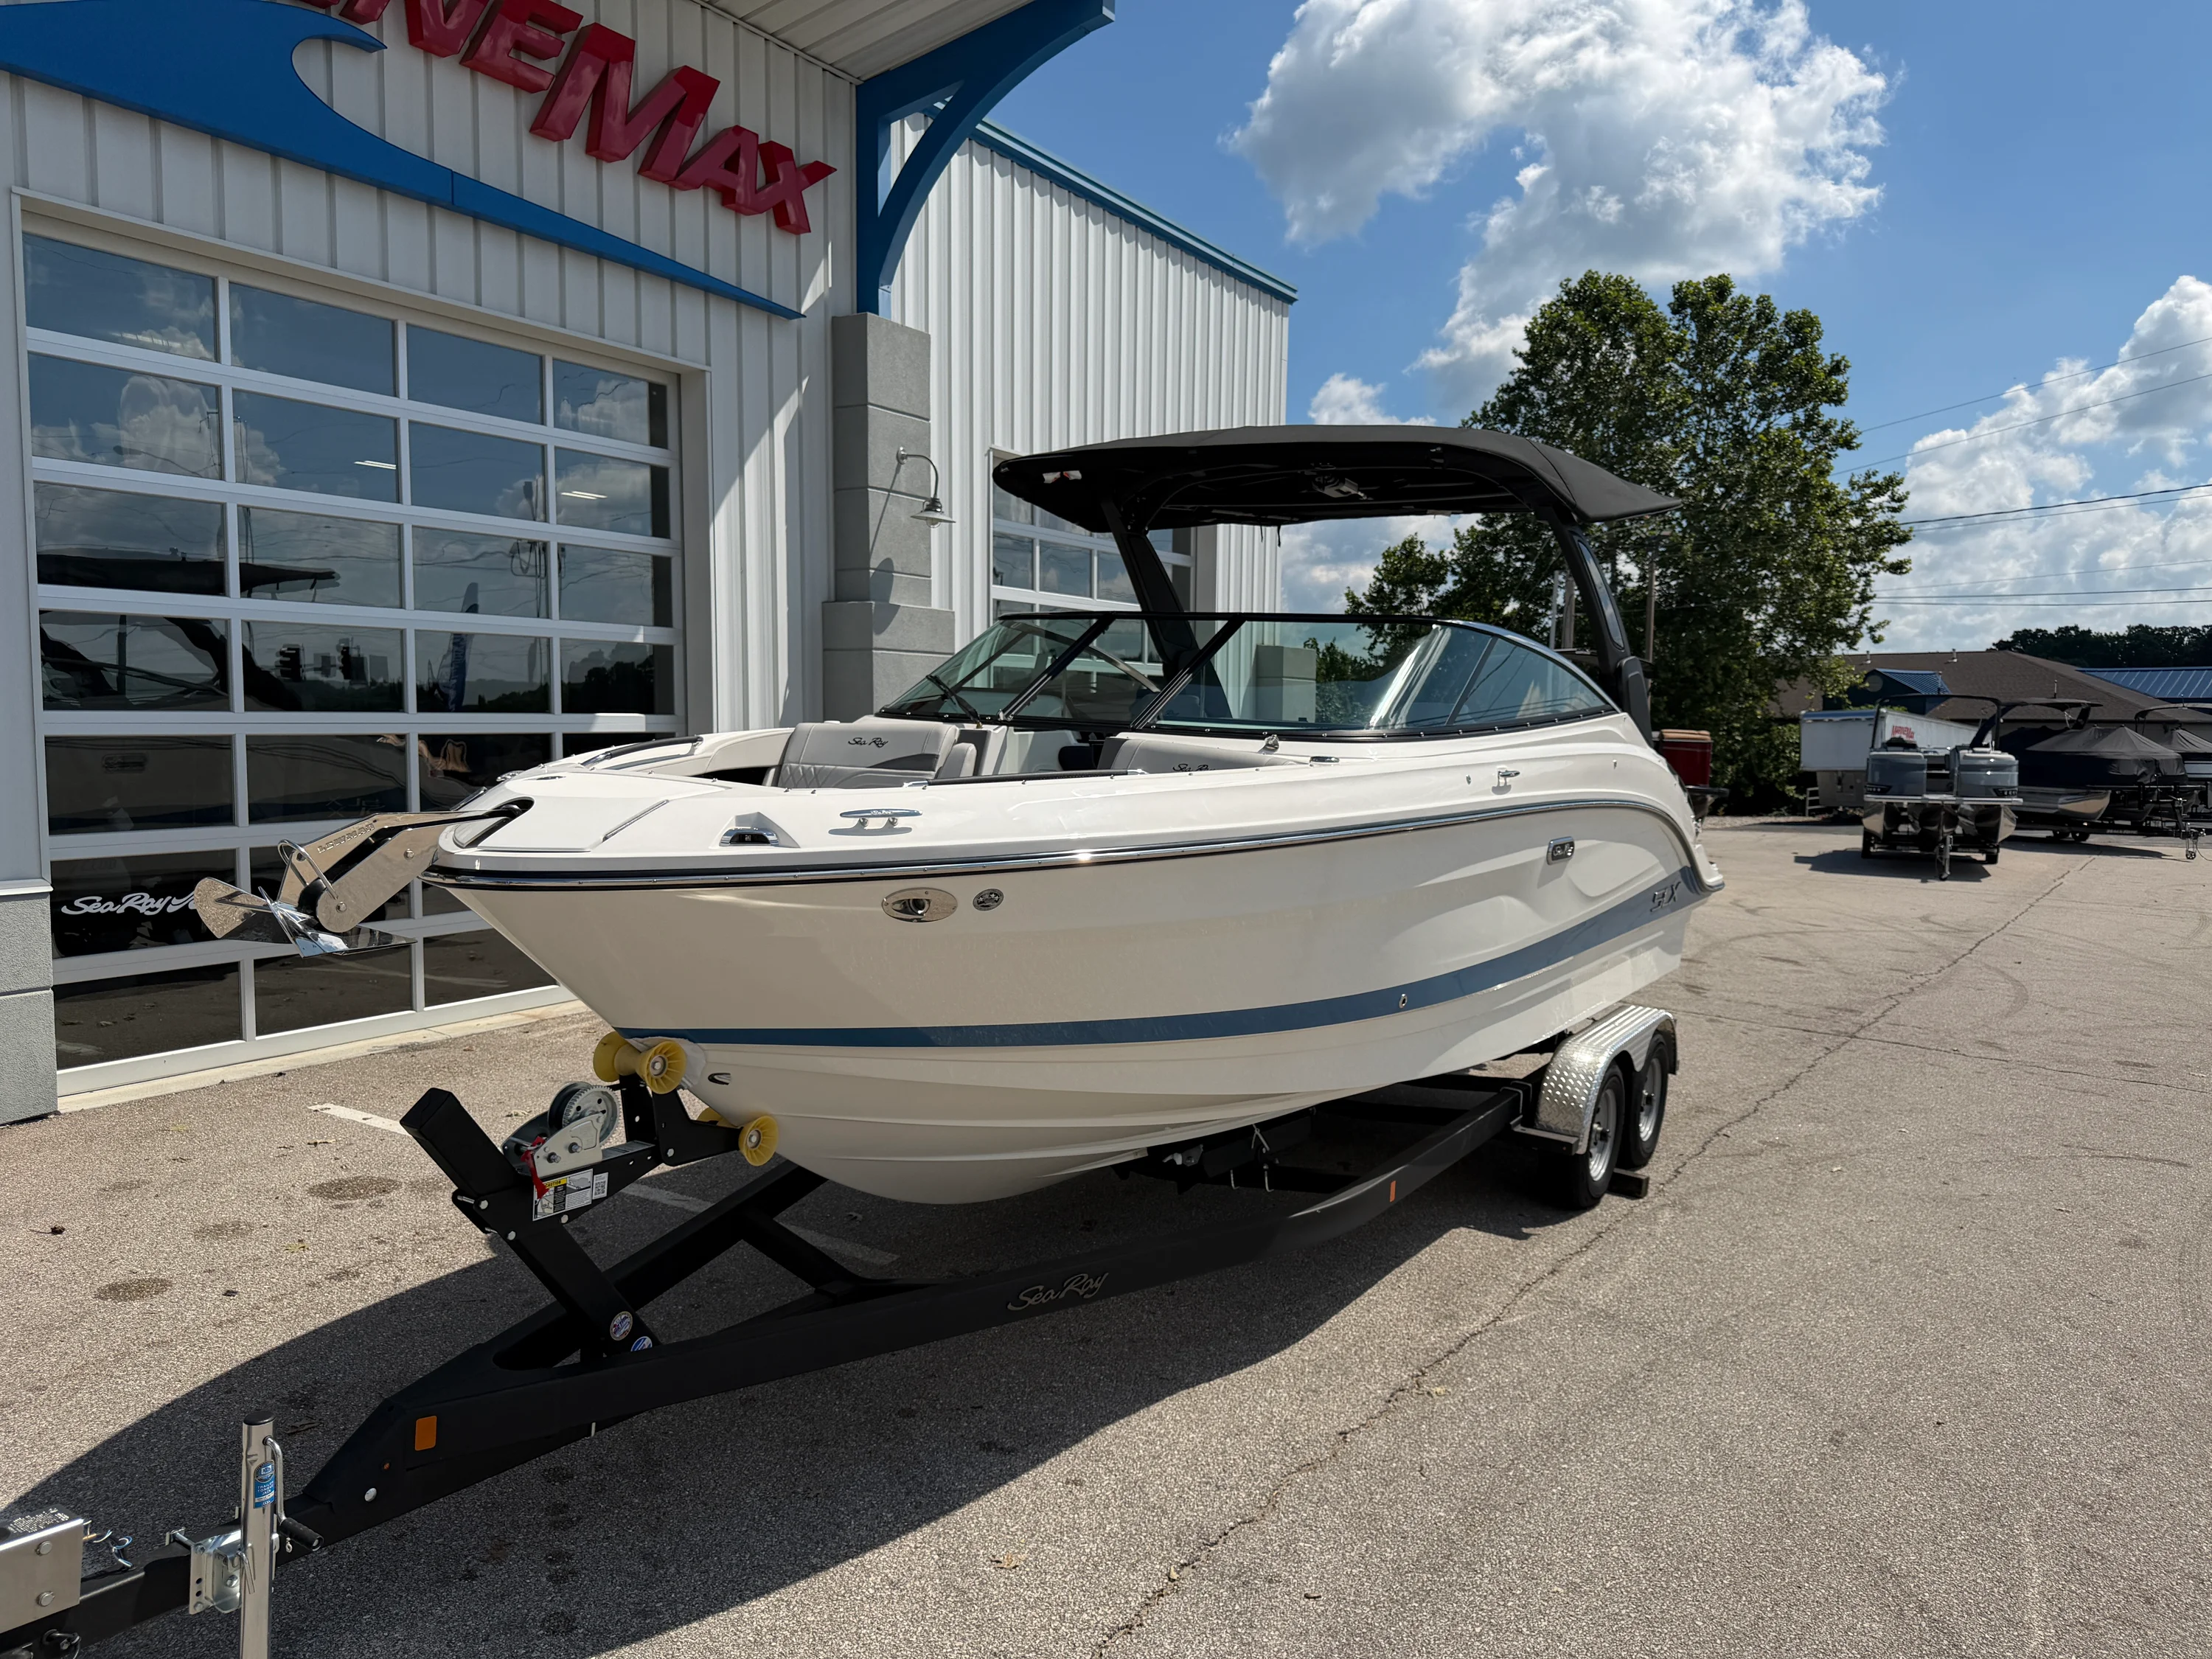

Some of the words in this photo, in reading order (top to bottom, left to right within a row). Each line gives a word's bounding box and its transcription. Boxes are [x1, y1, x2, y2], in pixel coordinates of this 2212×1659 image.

[299, 0, 838, 234] NEMAX
[847, 737, 868, 746] Sea
[868, 737, 889, 748] Ray
[1172, 763, 1194, 772] Sea
[317, 823, 375, 854] LEWMAR
[61, 896, 118, 915] Sea
[116, 892, 172, 916] Ray
[1649, 881, 1682, 913] SLX
[1007, 1284, 1060, 1311] Sea
[1059, 1272, 1110, 1299] Ray
